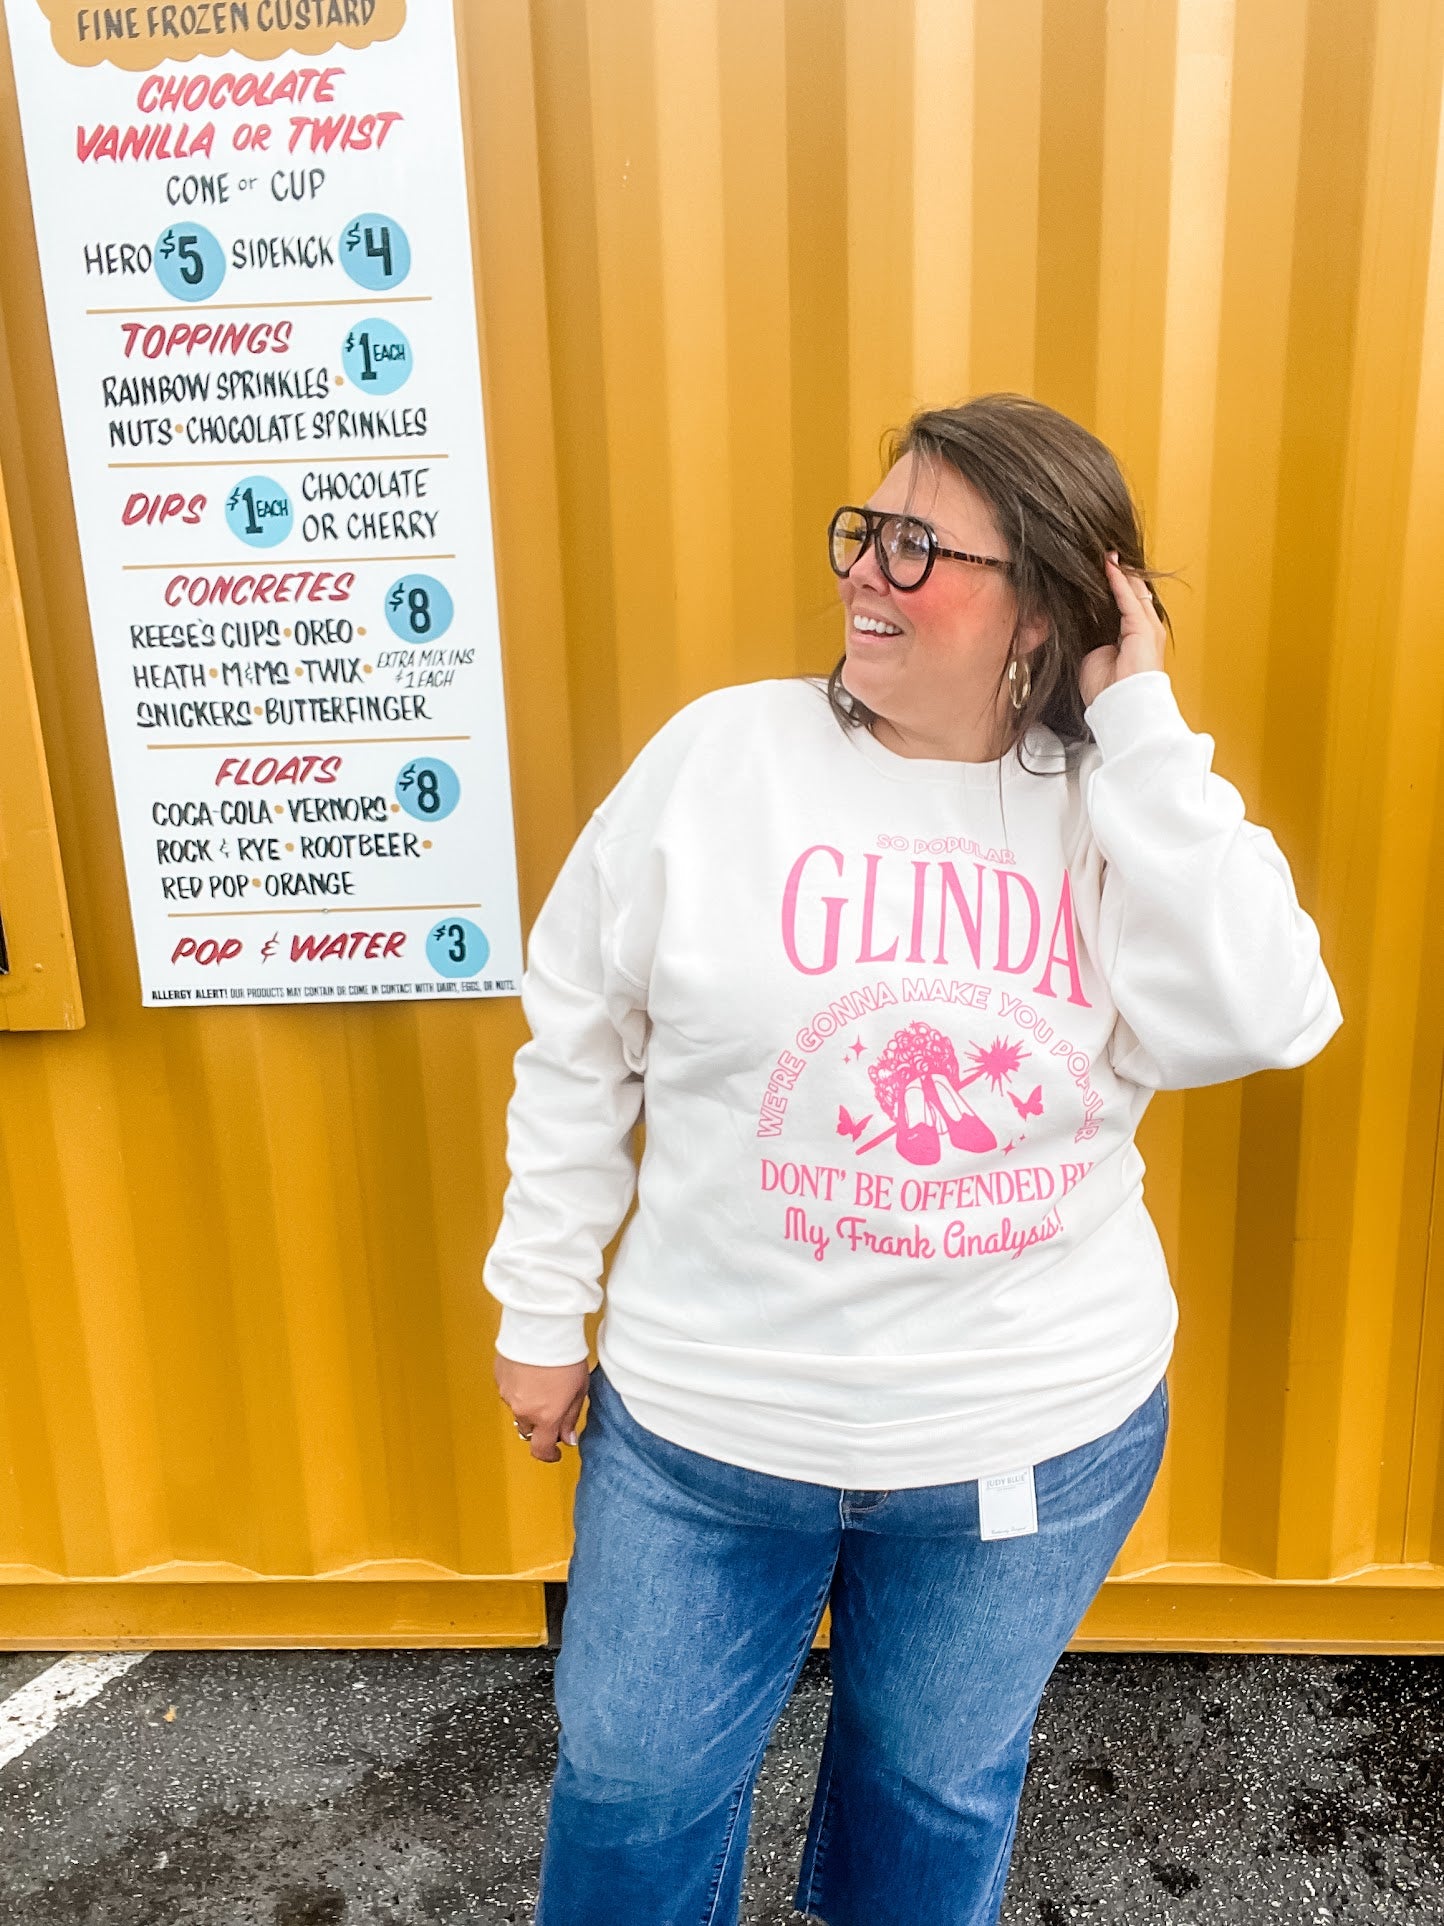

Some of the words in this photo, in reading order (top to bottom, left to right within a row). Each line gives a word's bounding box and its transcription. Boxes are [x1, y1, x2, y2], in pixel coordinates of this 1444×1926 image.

[77, 7, 140, 41] FINE
[146, 2, 249, 39] FROZEN
[257, 0, 375, 32] CUSTARD
[137, 67, 345, 114] CHOCOLATE
[76, 122, 215, 163] VANILLA
[232, 123, 271, 152] OR
[289, 112, 404, 154] TWIST
[167, 172, 230, 206] CONE
[271, 168, 325, 200] CUP
[84, 243, 151, 275] HERO
[159, 230, 204, 285] $5
[232, 236, 334, 271] SIDEKICK
[346, 223, 392, 276] $4
[121, 320, 293, 359] TOPPINGS
[345, 332, 377, 380] $1
[374, 344, 406, 361] EACH
[102, 373, 209, 407] RAINBOW
[217, 368, 329, 400] SPRINKLES
[109, 417, 172, 447] NUTS
[186, 414, 307, 443] CHOCOLATE
[313, 408, 427, 439] SPRINKLES
[303, 468, 429, 501] CHOCOLATE
[121, 493, 207, 526] DIPS
[227, 486, 263, 534] $1
[258, 499, 288, 517] EACH
[303, 513, 339, 541] OR
[348, 510, 439, 540] CHERRY
[164, 572, 356, 607] CONCRETES
[388, 583, 430, 634] $8
[130, 619, 215, 649] REESE'S
[222, 619, 281, 647] CUPS
[295, 619, 353, 646] OREO
[134, 663, 206, 690] HEATH
[222, 659, 290, 687] M&MS
[302, 658, 364, 683] TWIX
[377, 650, 415, 668] EXTRA
[418, 669, 455, 687] EACH
[137, 701, 253, 729] SNICKERS
[265, 695, 432, 725] BUTTERFINGER
[215, 755, 343, 787] FLOATS
[398, 764, 440, 814] $8
[152, 800, 273, 827] COCA-COLA
[287, 796, 388, 824] VERNORS
[156, 838, 213, 865] ROCK
[219, 839, 230, 859] &
[238, 837, 281, 861] RYE
[876, 834, 909, 852] SO
[913, 836, 1016, 865] POPULAR
[162, 876, 203, 899] RED
[210, 874, 249, 898] POP
[265, 872, 355, 897] ORANGE
[171, 937, 243, 966] POP
[262, 931, 279, 963] &
[290, 931, 407, 962] WATER
[433, 924, 465, 963] $3
[781, 844, 1093, 1008] GLINDA
[152, 990, 192, 1000] ALLERGY
[196, 988, 228, 999] ALERT!
[231, 988, 244, 998] OUR
[247, 988, 284, 998] PRODUCTS
[286, 987, 301, 997] MAY
[304, 986, 335, 997] CONTAIN
[338, 986, 346, 995] OR
[349, 985, 368, 995] COME
[372, 985, 378, 994] IN
[381, 983, 412, 994] CONTACT
[416, 983, 433, 993] WITH
[484, 981, 493, 991] OR
[757, 1049, 806, 1138] WE'RE
[796, 981, 899, 1053] GONNA
[902, 978, 992, 1010] MAKE
[998, 992, 1055, 1045] YOU
[761, 1159, 847, 1201] DONT'
[854, 1172, 894, 1211] BE
[900, 1164, 1055, 1213] OFFENDED
[784, 1207, 830, 1261] My
[836, 1216, 935, 1259] Frank
